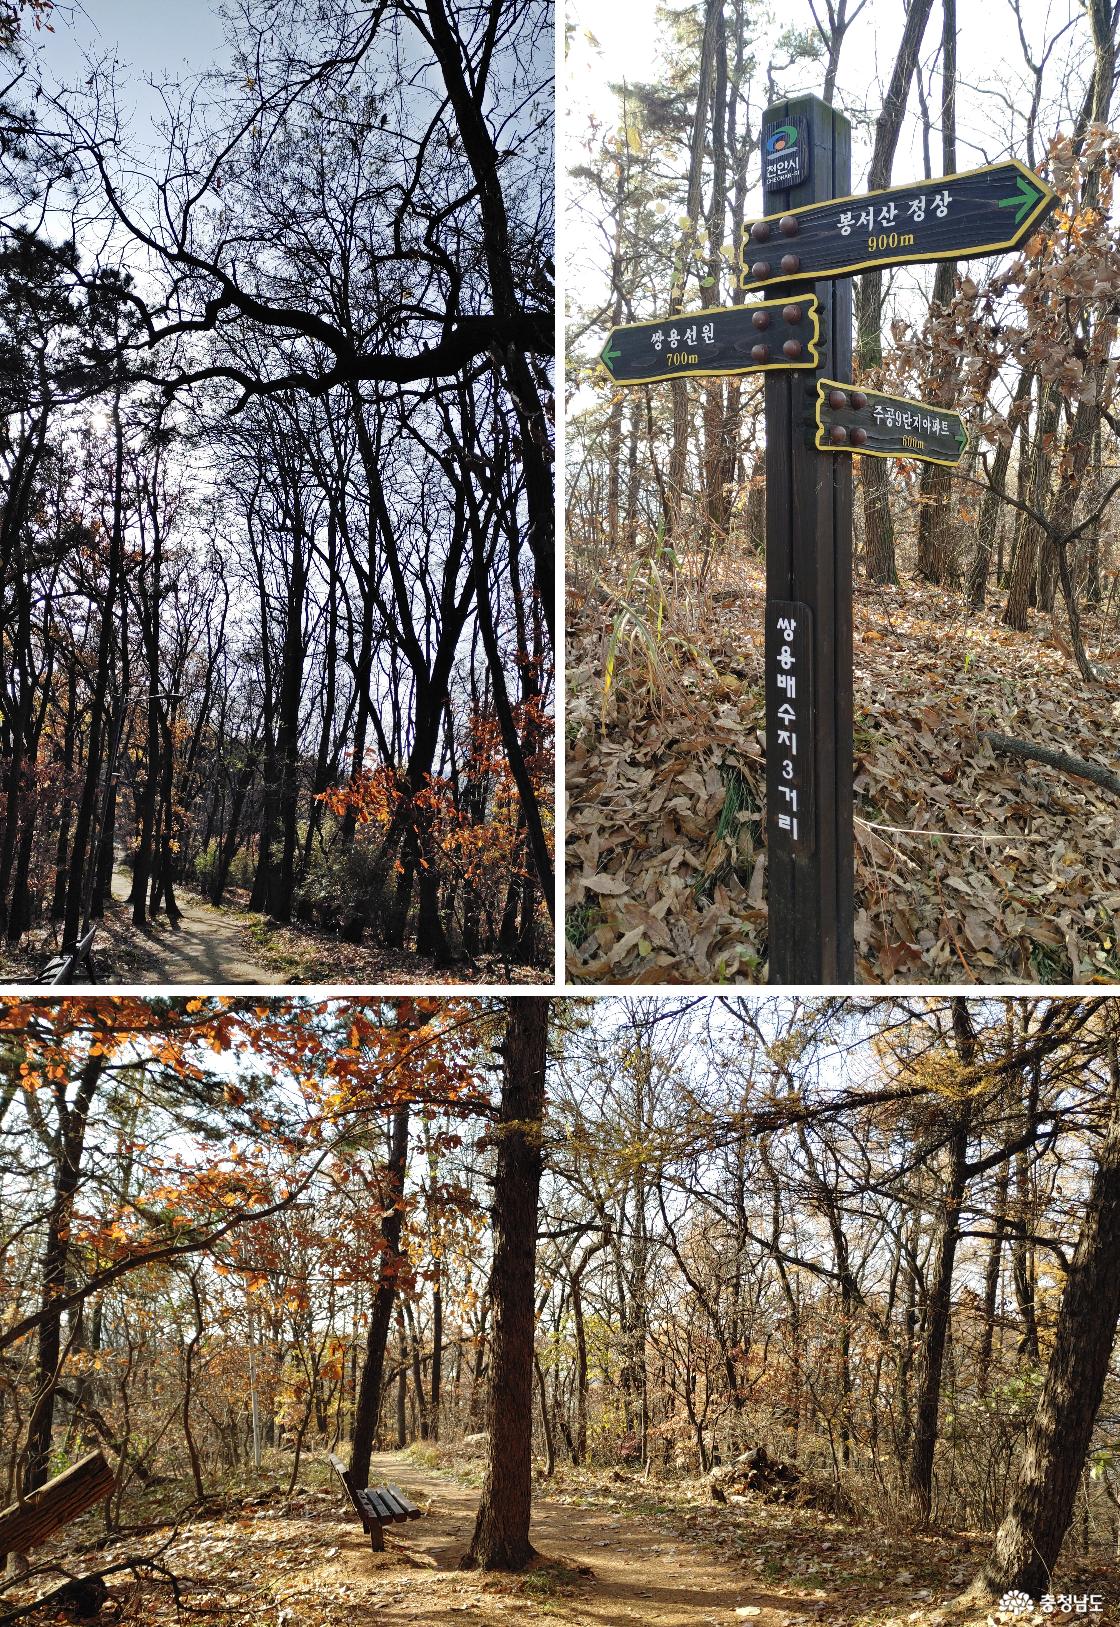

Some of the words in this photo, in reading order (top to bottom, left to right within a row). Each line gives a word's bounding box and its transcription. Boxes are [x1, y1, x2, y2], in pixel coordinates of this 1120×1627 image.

[766, 157, 799, 178] 천안시
[836, 202, 899, 236] 봉서산
[906, 190, 953, 222] 정상
[868, 232, 914, 252] 900m
[650, 322, 715, 351] 쌍용선원
[666, 351, 699, 367] 700m
[873, 405, 950, 437] 주공9단지아파트
[902, 434, 925, 450] 600m
[776, 617, 798, 841] 쌍용배수지3거리
